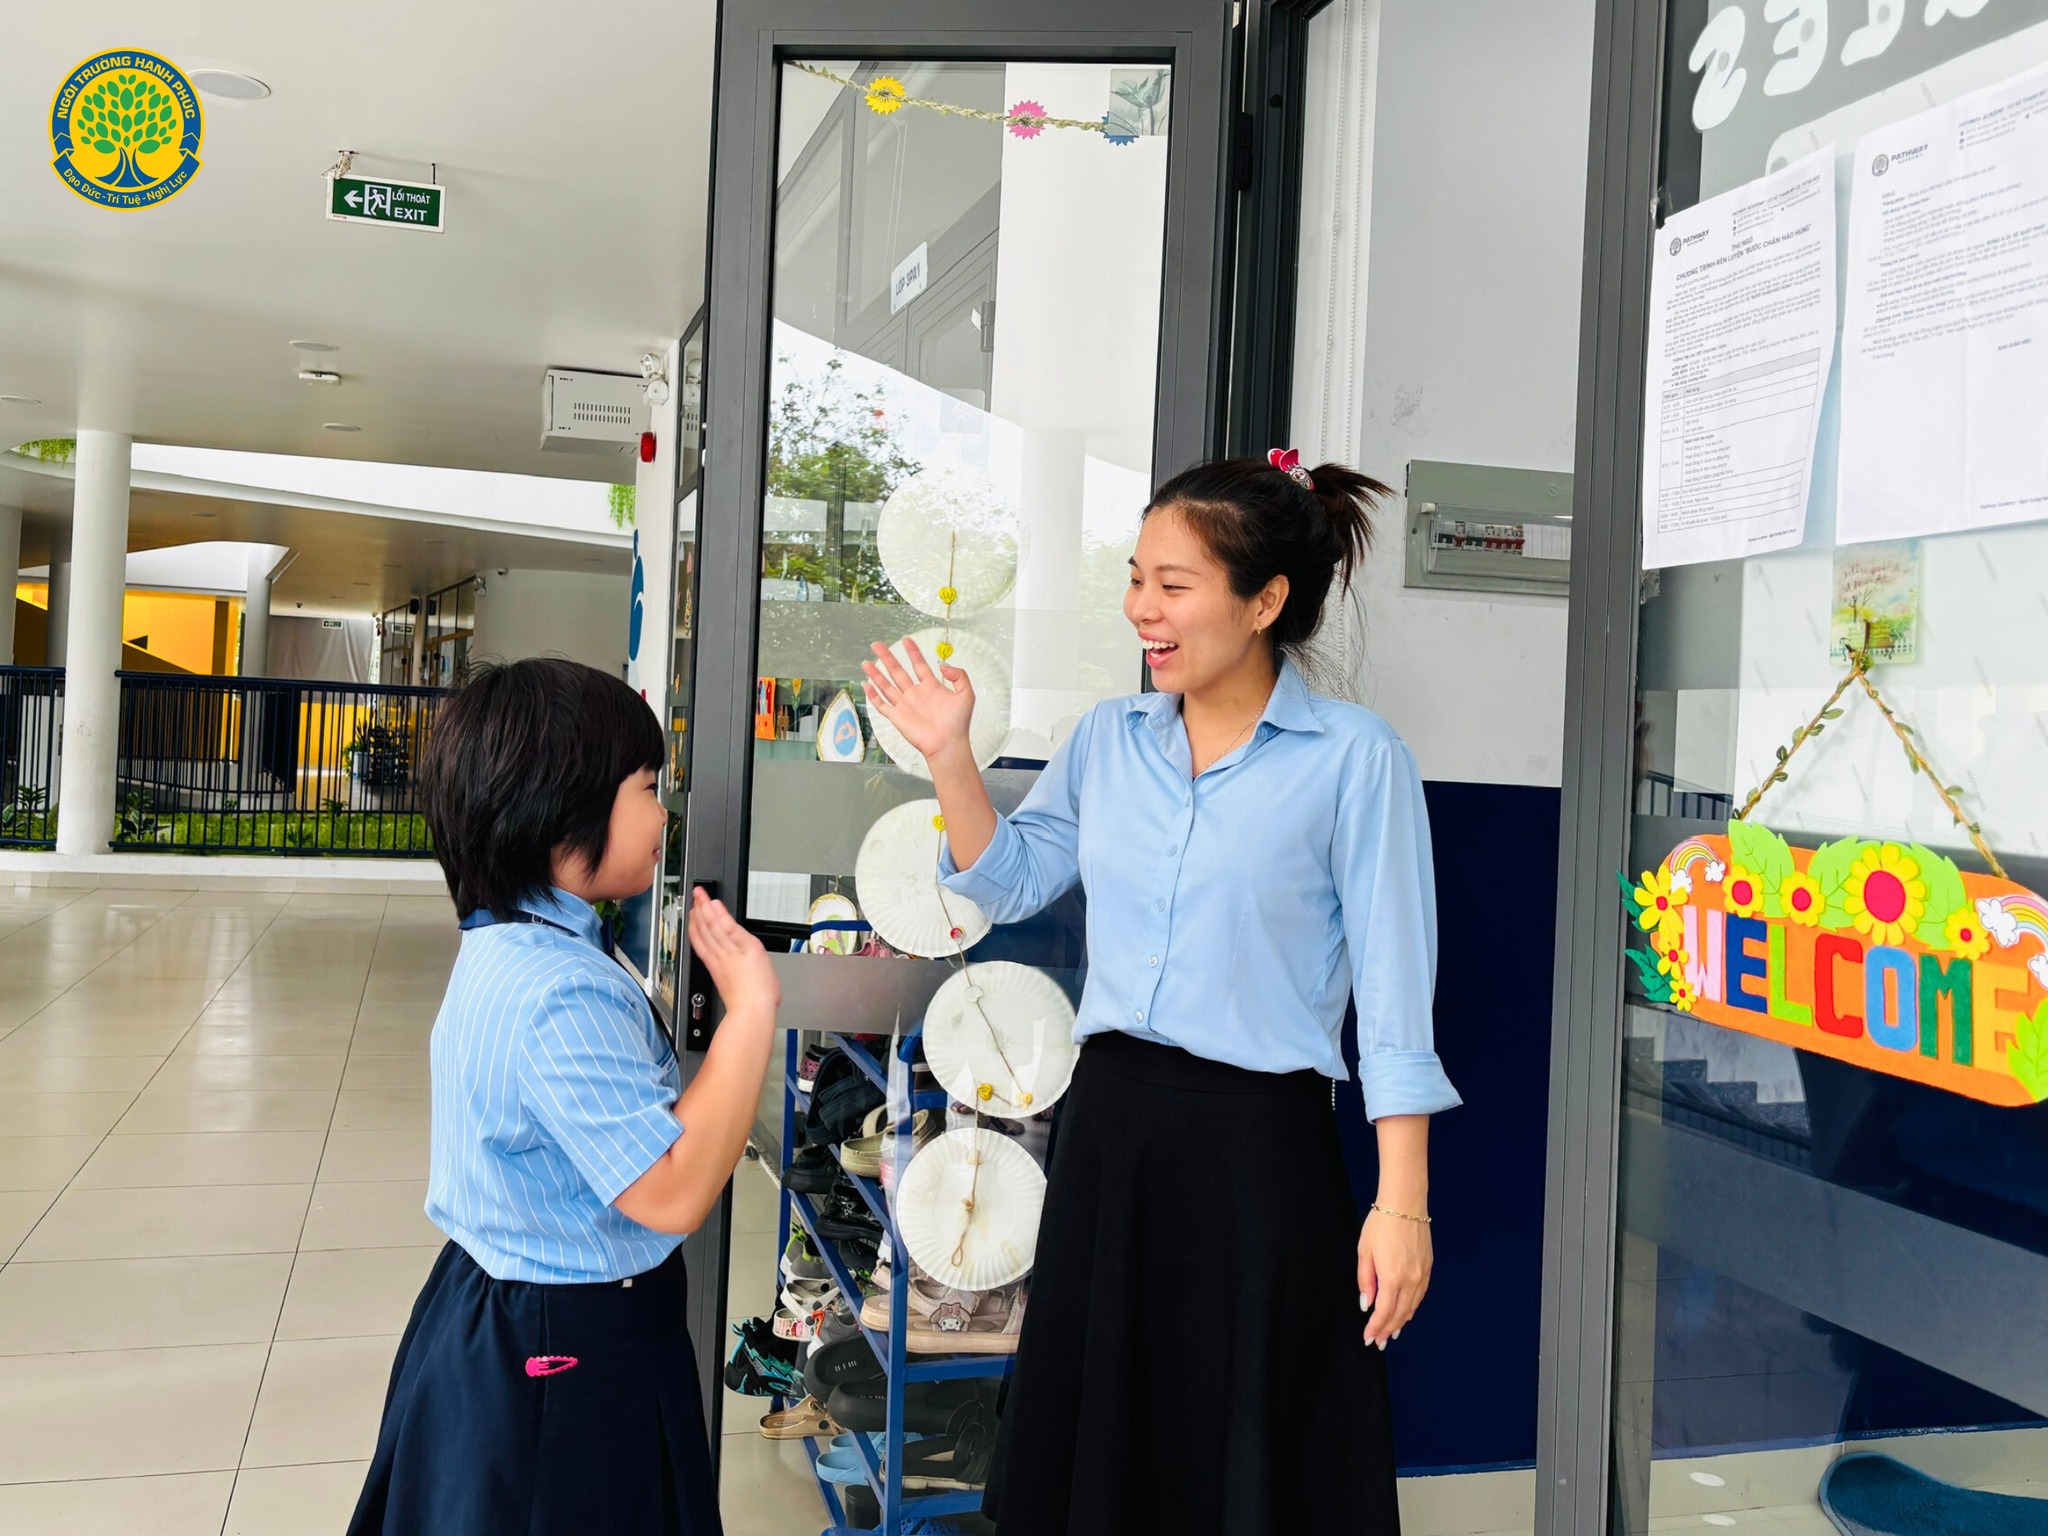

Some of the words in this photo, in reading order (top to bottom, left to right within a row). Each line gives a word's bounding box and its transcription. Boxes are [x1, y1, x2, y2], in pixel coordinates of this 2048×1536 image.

[1890, 143, 1929, 162] PATHWAY
[392, 188, 405, 202] LỐI
[406, 191, 431, 204] THOÁT
[394, 207, 428, 221] EXIT
[1683, 905, 2030, 1076] WELCOME
